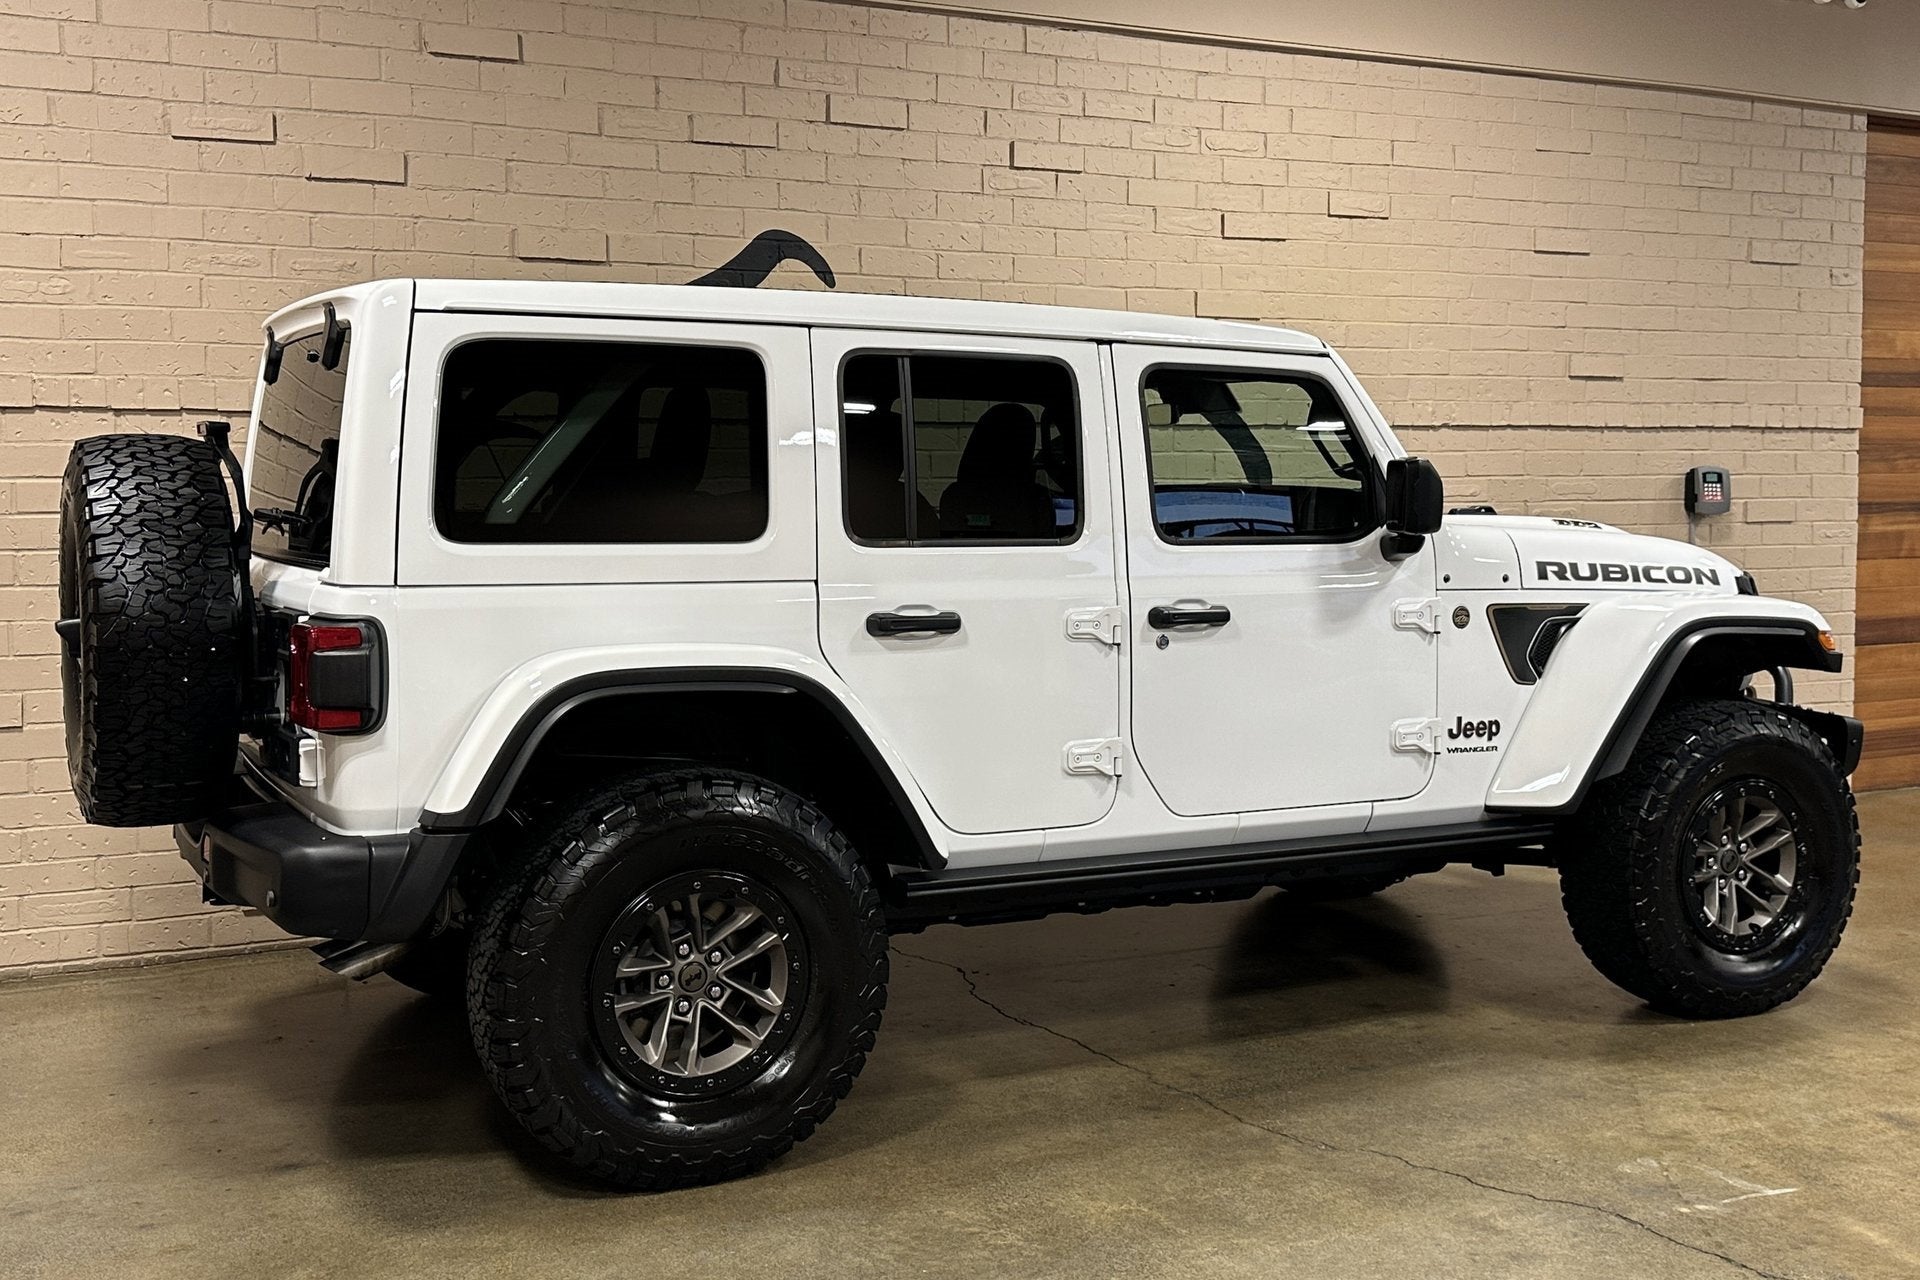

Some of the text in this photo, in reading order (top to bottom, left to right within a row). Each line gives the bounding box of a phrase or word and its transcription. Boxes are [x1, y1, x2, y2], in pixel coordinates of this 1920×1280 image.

[1535, 560, 1721, 586] RUBICON
[1447, 716, 1501, 742] Jeep
[1446, 745, 1498, 754] WRANGLER
